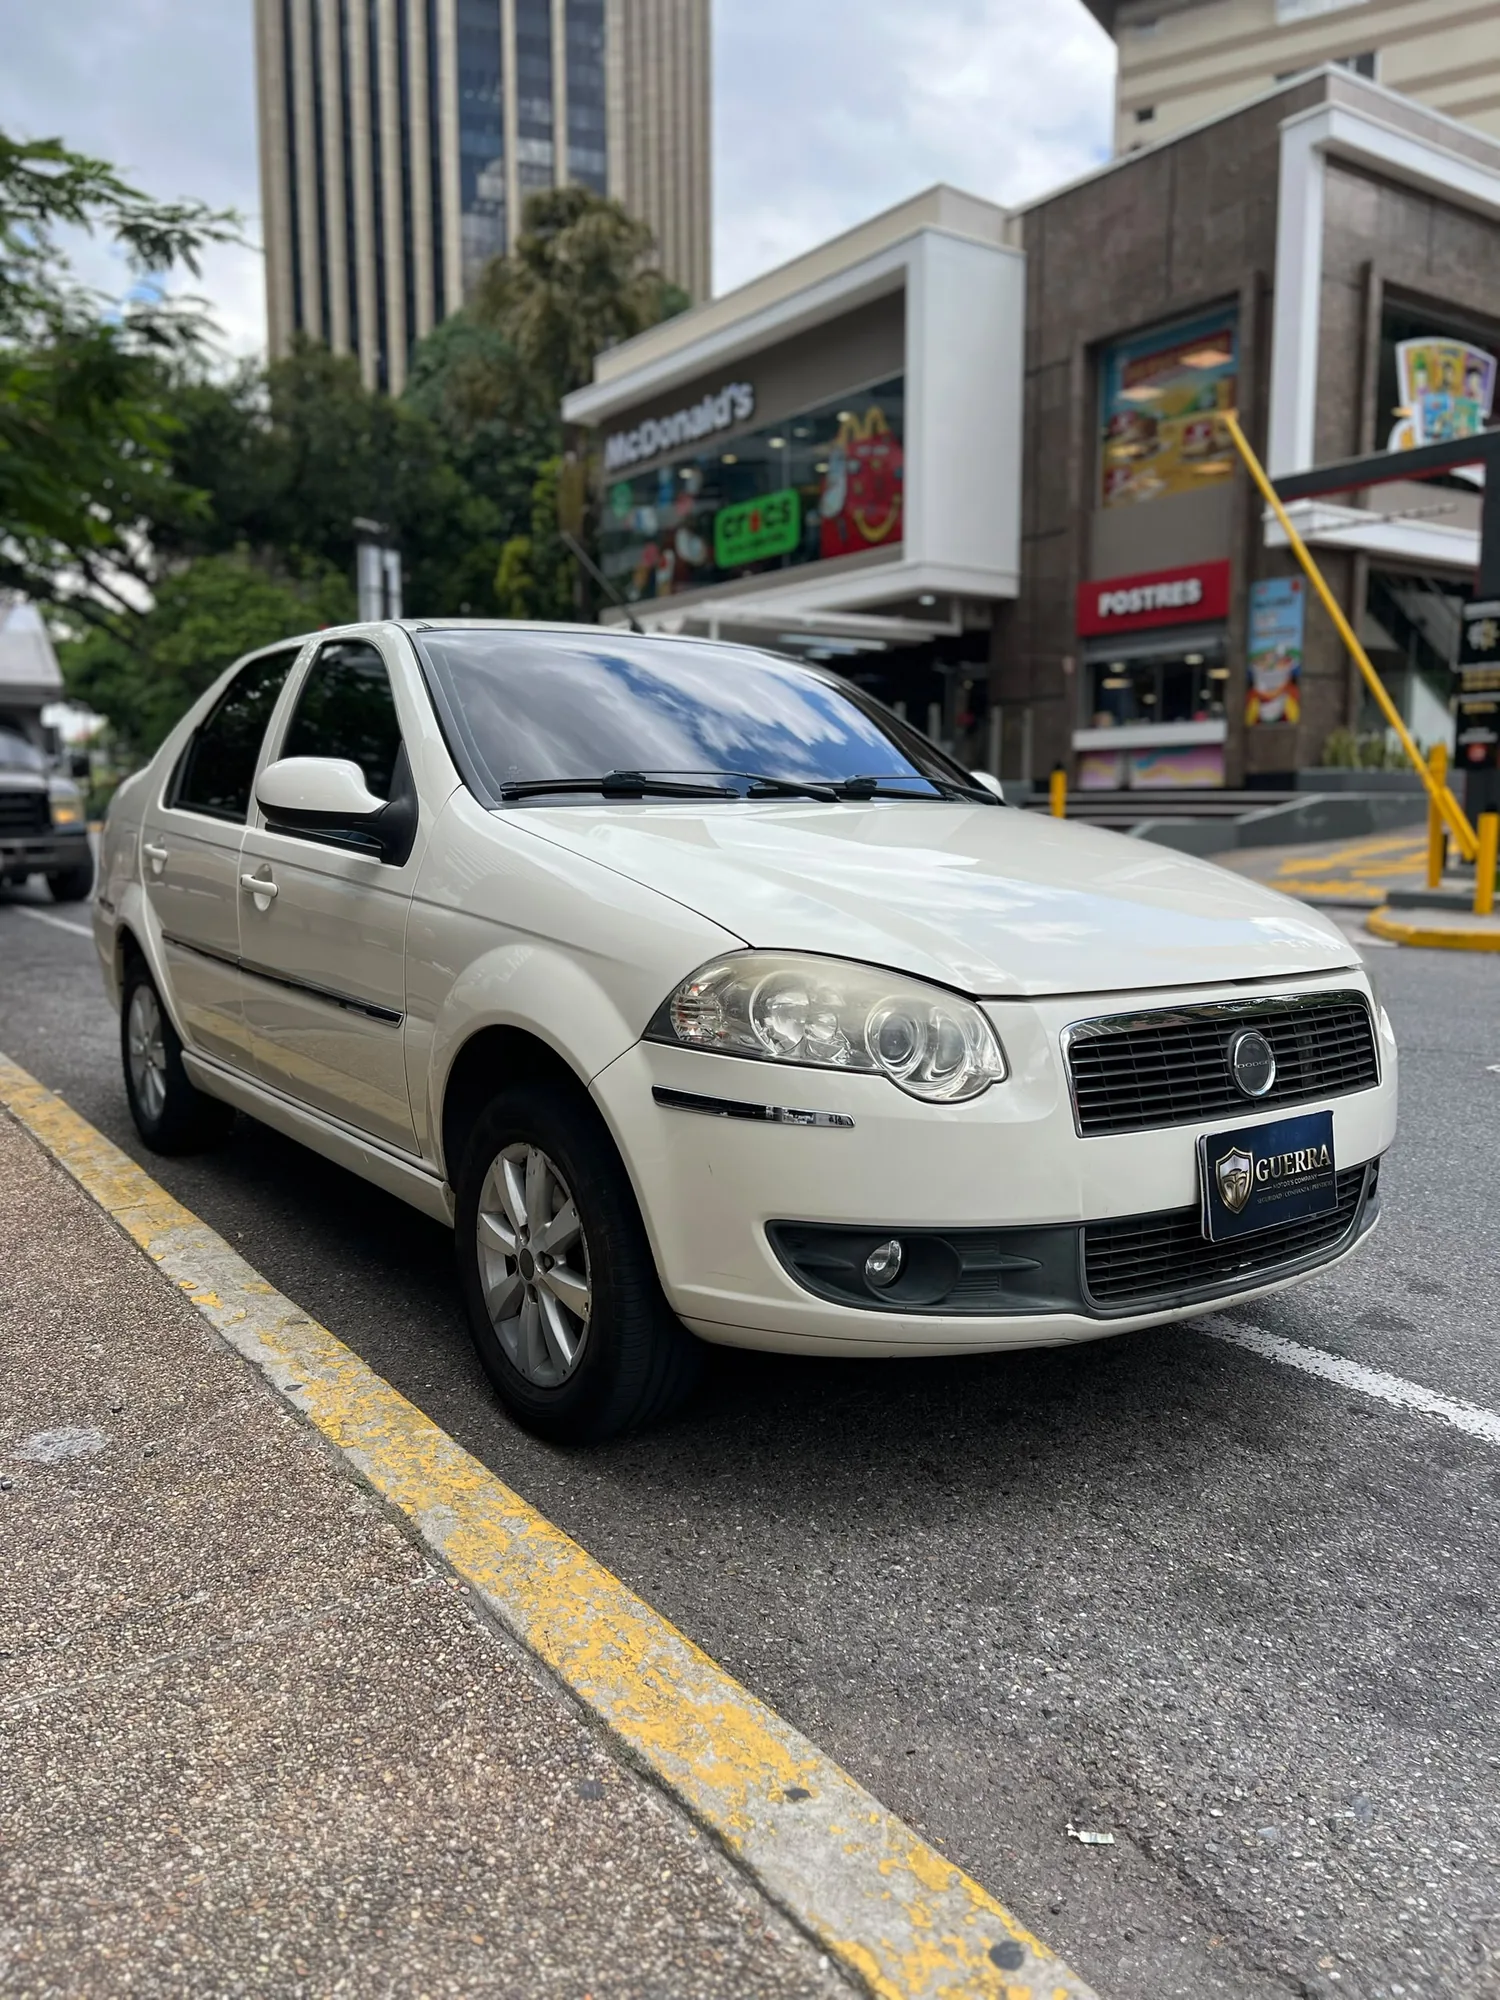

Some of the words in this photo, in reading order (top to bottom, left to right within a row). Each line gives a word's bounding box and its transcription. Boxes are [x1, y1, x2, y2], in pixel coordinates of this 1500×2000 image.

[605, 383, 754, 469] McDonald's
[1098, 578, 1202, 617] POSTRES
[1256, 1144, 1332, 1181] GUERRA
